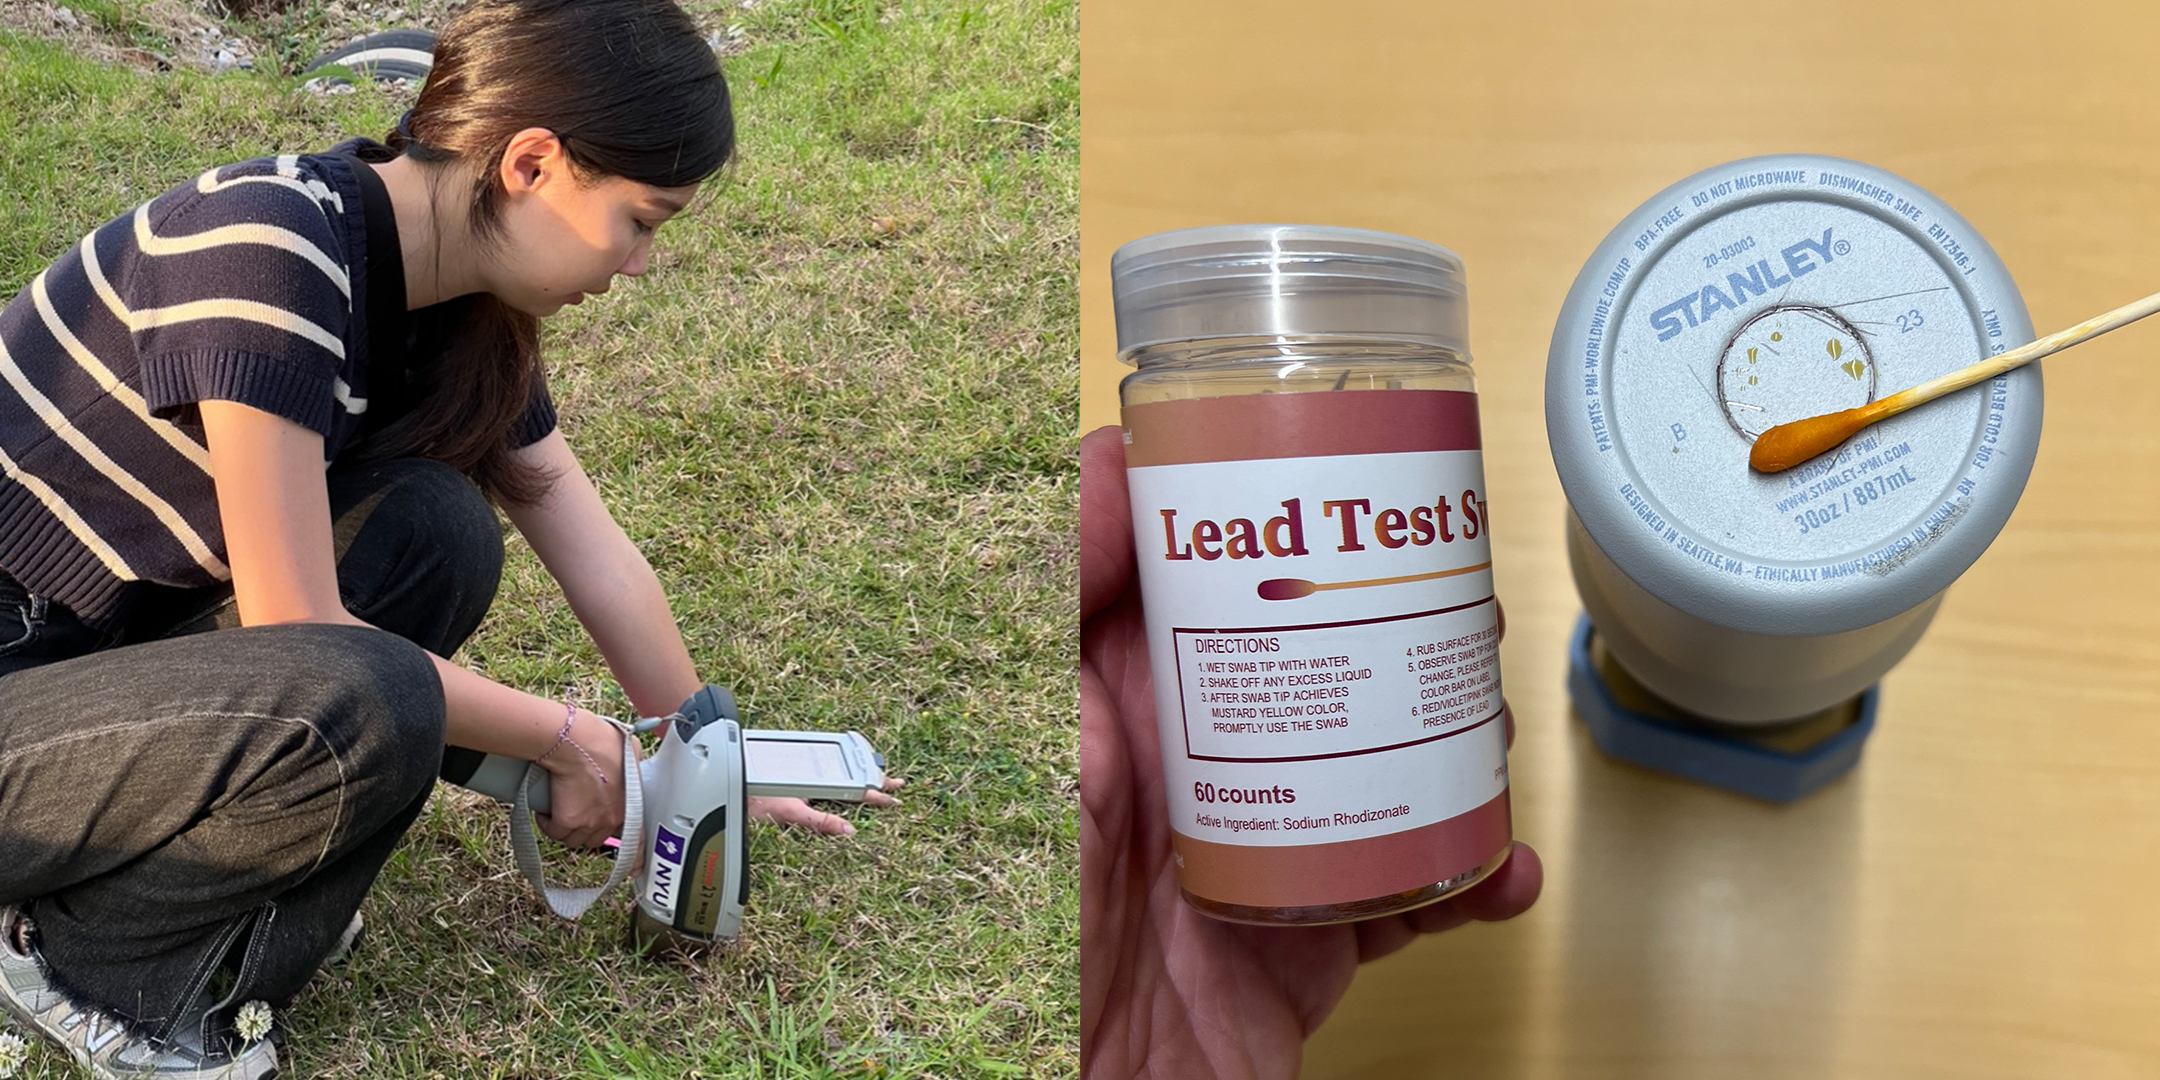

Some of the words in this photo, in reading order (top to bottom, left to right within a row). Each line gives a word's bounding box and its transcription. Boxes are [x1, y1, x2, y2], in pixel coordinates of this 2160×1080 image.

[1691, 192, 1709, 207] DO
[1709, 181, 1732, 199] NOT
[1734, 170, 1806, 191] MICROWAVE
[1819, 173, 1894, 205] DISHWASHER
[1894, 199, 1923, 222] SAFE
[1634, 206, 1685, 251] BPA-FREE
[1703, 236, 1756, 268] 20-03003
[1927, 223, 1976, 275] EN12546-1
[1896, 309, 1924, 333] 23
[1982, 309, 2002, 337] ONLY
[1588, 398, 1613, 452] PATENTS:
[1671, 422, 1687, 442] B
[1985, 414, 2003, 445] COLD
[1788, 475, 1798, 488] A
[1797, 456, 1836, 484] BRAND
[1839, 448, 1852, 464] OF
[1853, 436, 1878, 456] PMI
[1973, 445, 1993, 469] FOR
[1776, 441, 1912, 514] WWW.STANLEY-PMI.COM
[1794, 503, 1841, 534] 30oz
[1843, 492, 1850, 513] /
[1853, 465, 1916, 505] 887mL
[1160, 497, 1309, 560] Lead
[1323, 495, 1455, 552] Test
[1620, 483, 1665, 532] DESIGNED
[1662, 527, 1679, 543] IN
[1754, 565, 1817, 582] ETHICALLY
[1821, 536, 1912, 580] MANUFACTURED
[1911, 526, 1927, 543] IN
[1923, 500, 1956, 533] CHINA
[1195, 637, 1280, 653] DIRECTIONS
[1406, 648, 1415, 657] 4.
[1416, 643, 1435, 656] RUB
[1437, 635, 1469, 652] SURFACE
[1470, 632, 1481, 644] FOR
[1408, 662, 1416, 672] 5.
[1418, 653, 1457, 671] OBSERVE
[1458, 648, 1476, 662] SWAB
[1476, 644, 1484, 657] TIP
[1228, 662, 1257, 672] SWAB
[1259, 661, 1276, 672] TIP
[1278, 660, 1307, 671] WITH
[1309, 656, 1350, 668] WATER
[1419, 669, 1456, 685] CHANGE,
[1457, 660, 1480, 676] PLEASE
[1240, 677, 1261, 688] OFF
[1263, 676, 1285, 687] ANY
[1288, 673, 1333, 686] EXCESS
[1335, 669, 1372, 682] LIQUID
[1421, 684, 1450, 699] COLOR
[1451, 680, 1466, 693] BAR
[1466, 677, 1476, 688] ON
[1476, 671, 1491, 685] LABEL
[1210, 693, 1240, 703] AFTER
[1241, 692, 1271, 703] SWAB
[1273, 691, 1290, 702] TIP
[1293, 687, 1349, 701] ACHIEVES
[1211, 707, 1257, 718] MUSTARD
[1259, 706, 1303, 718] YELLOW
[1306, 702, 1348, 716] COLOR,
[1411, 706, 1420, 717] 6.
[1423, 708, 1466, 729] PRESENCE
[1466, 704, 1475, 716] OF
[1476, 699, 1489, 713] LEAD
[1213, 722, 1264, 733] PROMPTLY
[1266, 722, 1288, 733] USE
[1290, 720, 1313, 731] THE
[1316, 717, 1348, 730] SWAB
[1194, 781, 1215, 803] 60
[1218, 785, 1296, 804] counts
[1197, 812, 1221, 828] Active
[1224, 816, 1279, 833] Ingredient:
[1283, 816, 1330, 831] Sodium
[1334, 804, 1410, 826] Rhodizonate
[652, 862, 672, 908] NYU
